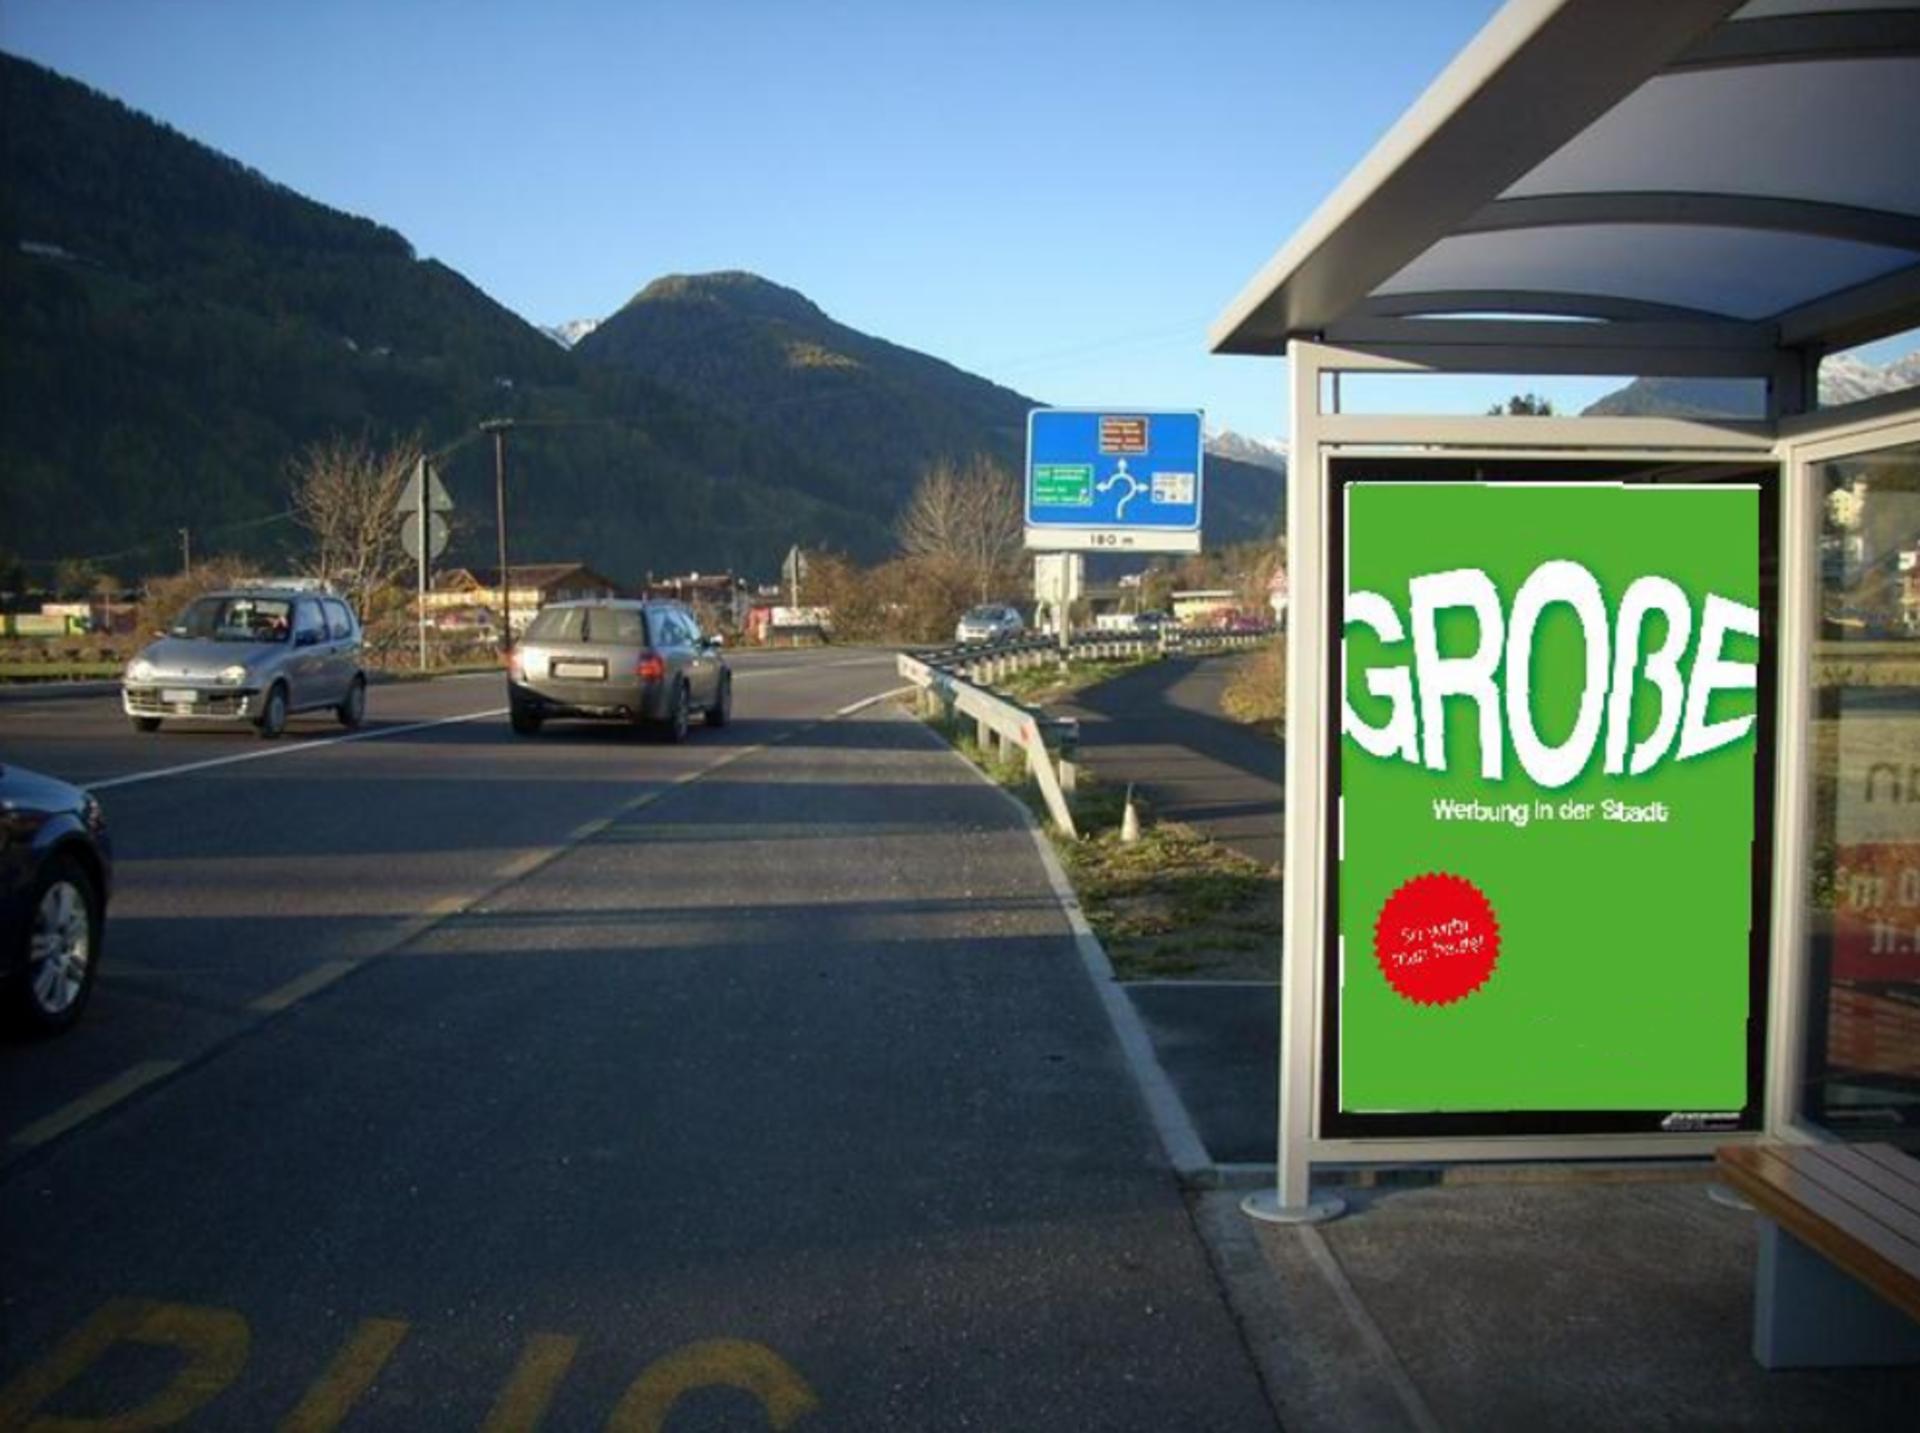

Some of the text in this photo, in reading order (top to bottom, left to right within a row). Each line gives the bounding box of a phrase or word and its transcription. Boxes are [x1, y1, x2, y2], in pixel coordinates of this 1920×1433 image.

[1433, 799, 1529, 827] Werbung
[1558, 799, 1595, 820] der
[1601, 799, 1669, 822] Stadt
